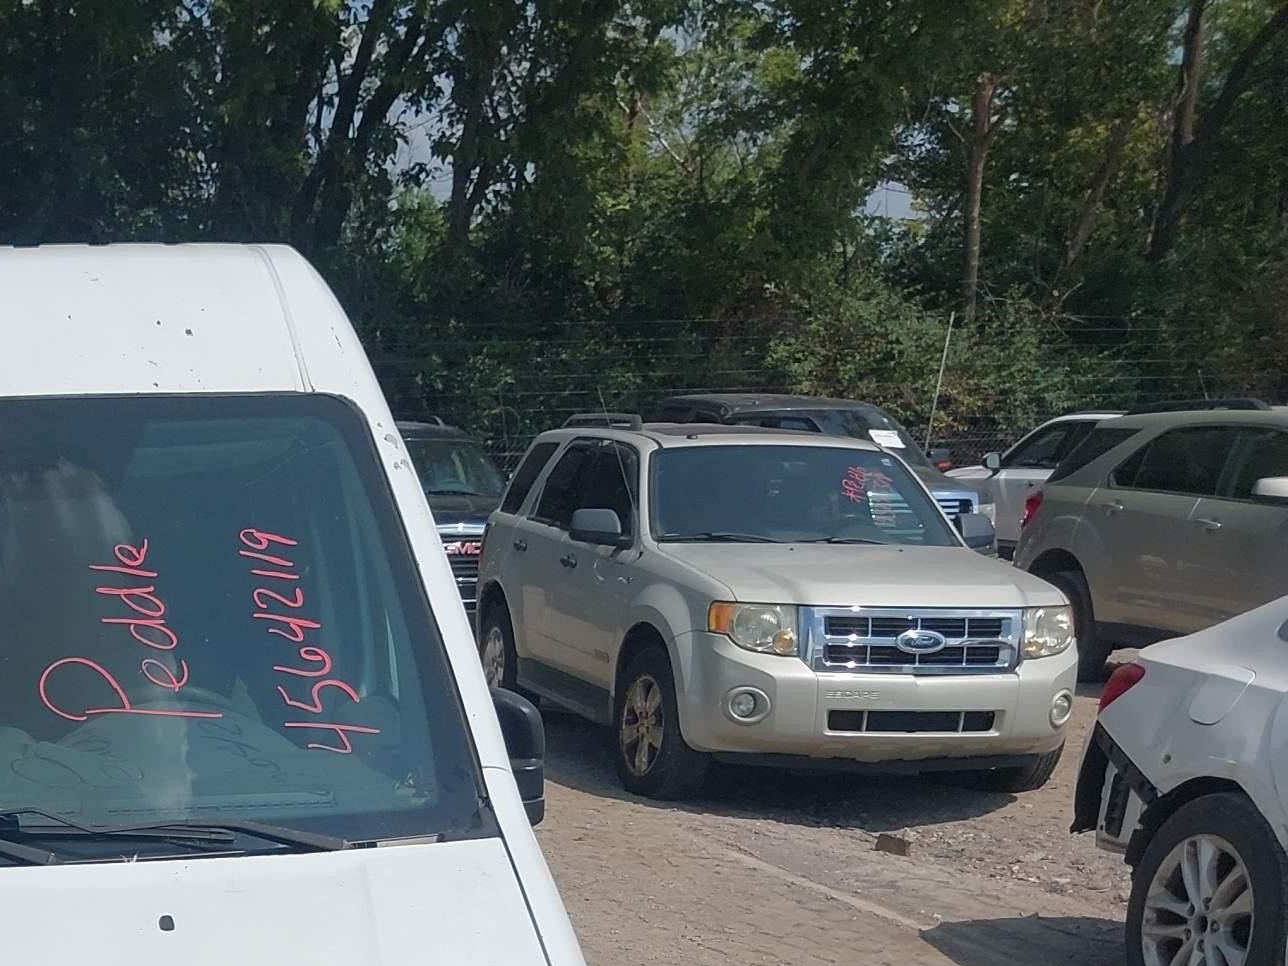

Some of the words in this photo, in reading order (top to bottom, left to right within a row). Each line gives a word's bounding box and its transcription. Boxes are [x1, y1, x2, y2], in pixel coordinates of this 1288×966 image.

[39, 538, 223, 721] Peddle
[239, 528, 380, 754] 45642119
[824, 689, 880, 700] ESCAPE
